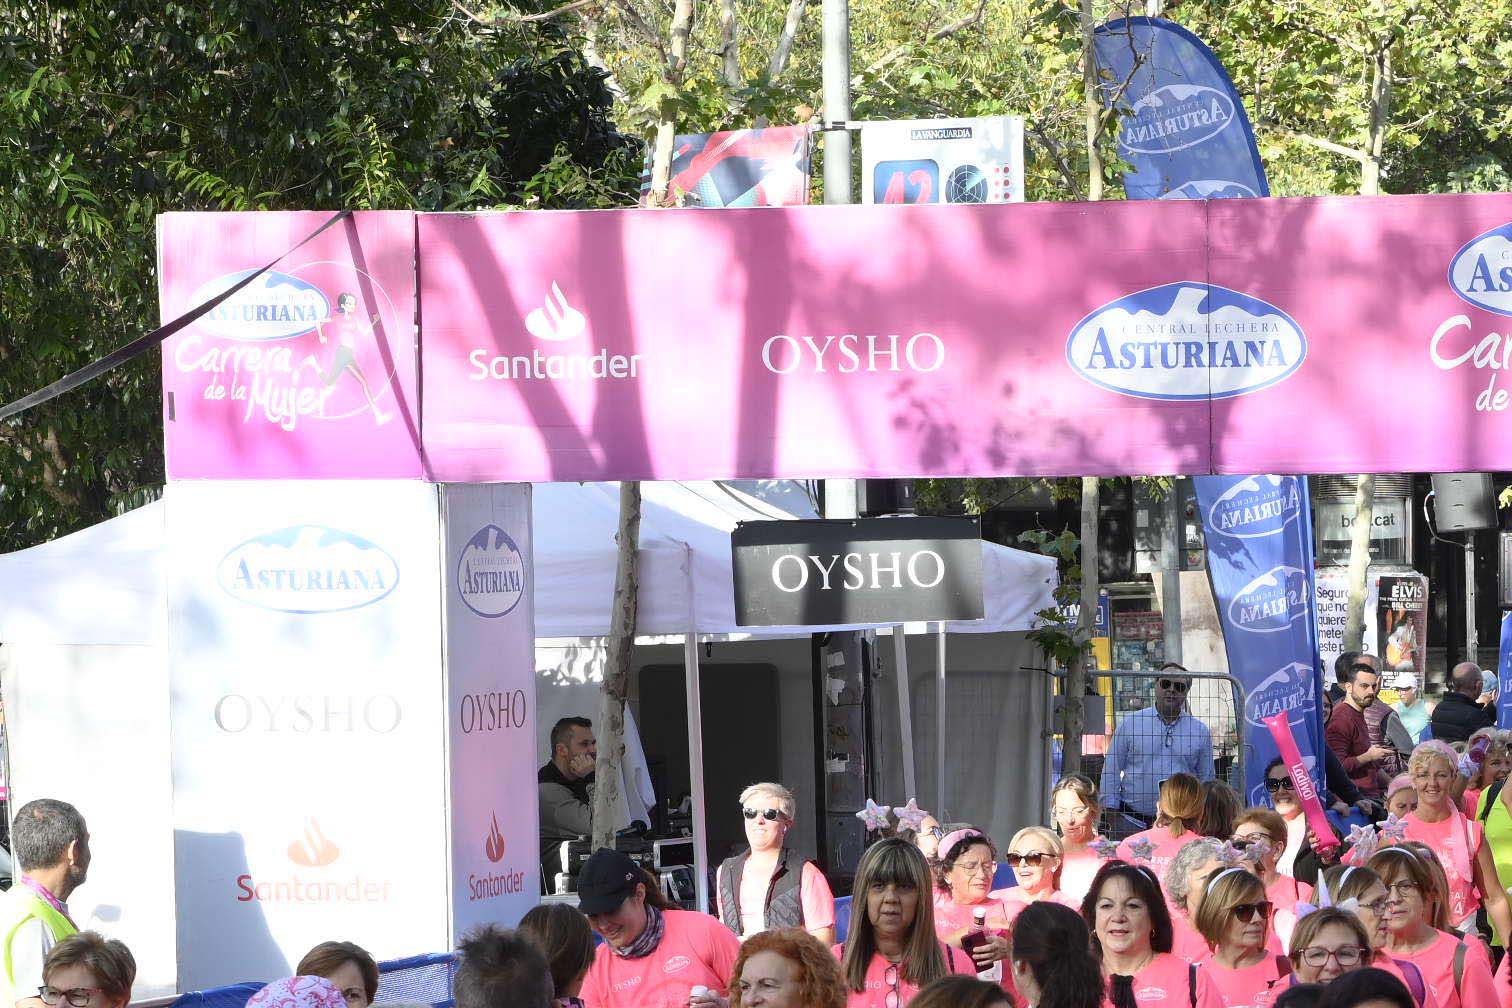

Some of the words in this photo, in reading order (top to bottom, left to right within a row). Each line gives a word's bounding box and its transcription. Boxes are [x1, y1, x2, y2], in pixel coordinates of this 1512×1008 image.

[1121, 321, 1197, 335] CENTRAL
[1206, 320, 1280, 334] LECHERA
[175, 336, 292, 373] Carrera
[470, 348, 645, 380] Santander
[762, 333, 945, 374] OYSHO
[1085, 326, 1287, 369] ASTURIANA
[204, 376, 226, 401] de
[244, 368, 338, 432] Mujer
[1475, 374, 1509, 411] de
[232, 557, 386, 590] ASTURIANA
[463, 554, 521, 594] ASTURIANA
[772, 550, 945, 592] OYSHO
[1392, 586, 1422, 598] ELVIS
[214, 694, 401, 734] OYSHO
[461, 690, 526, 734] OYSHO
[236, 874, 391, 902] Santander
[469, 868, 524, 901] Santander
